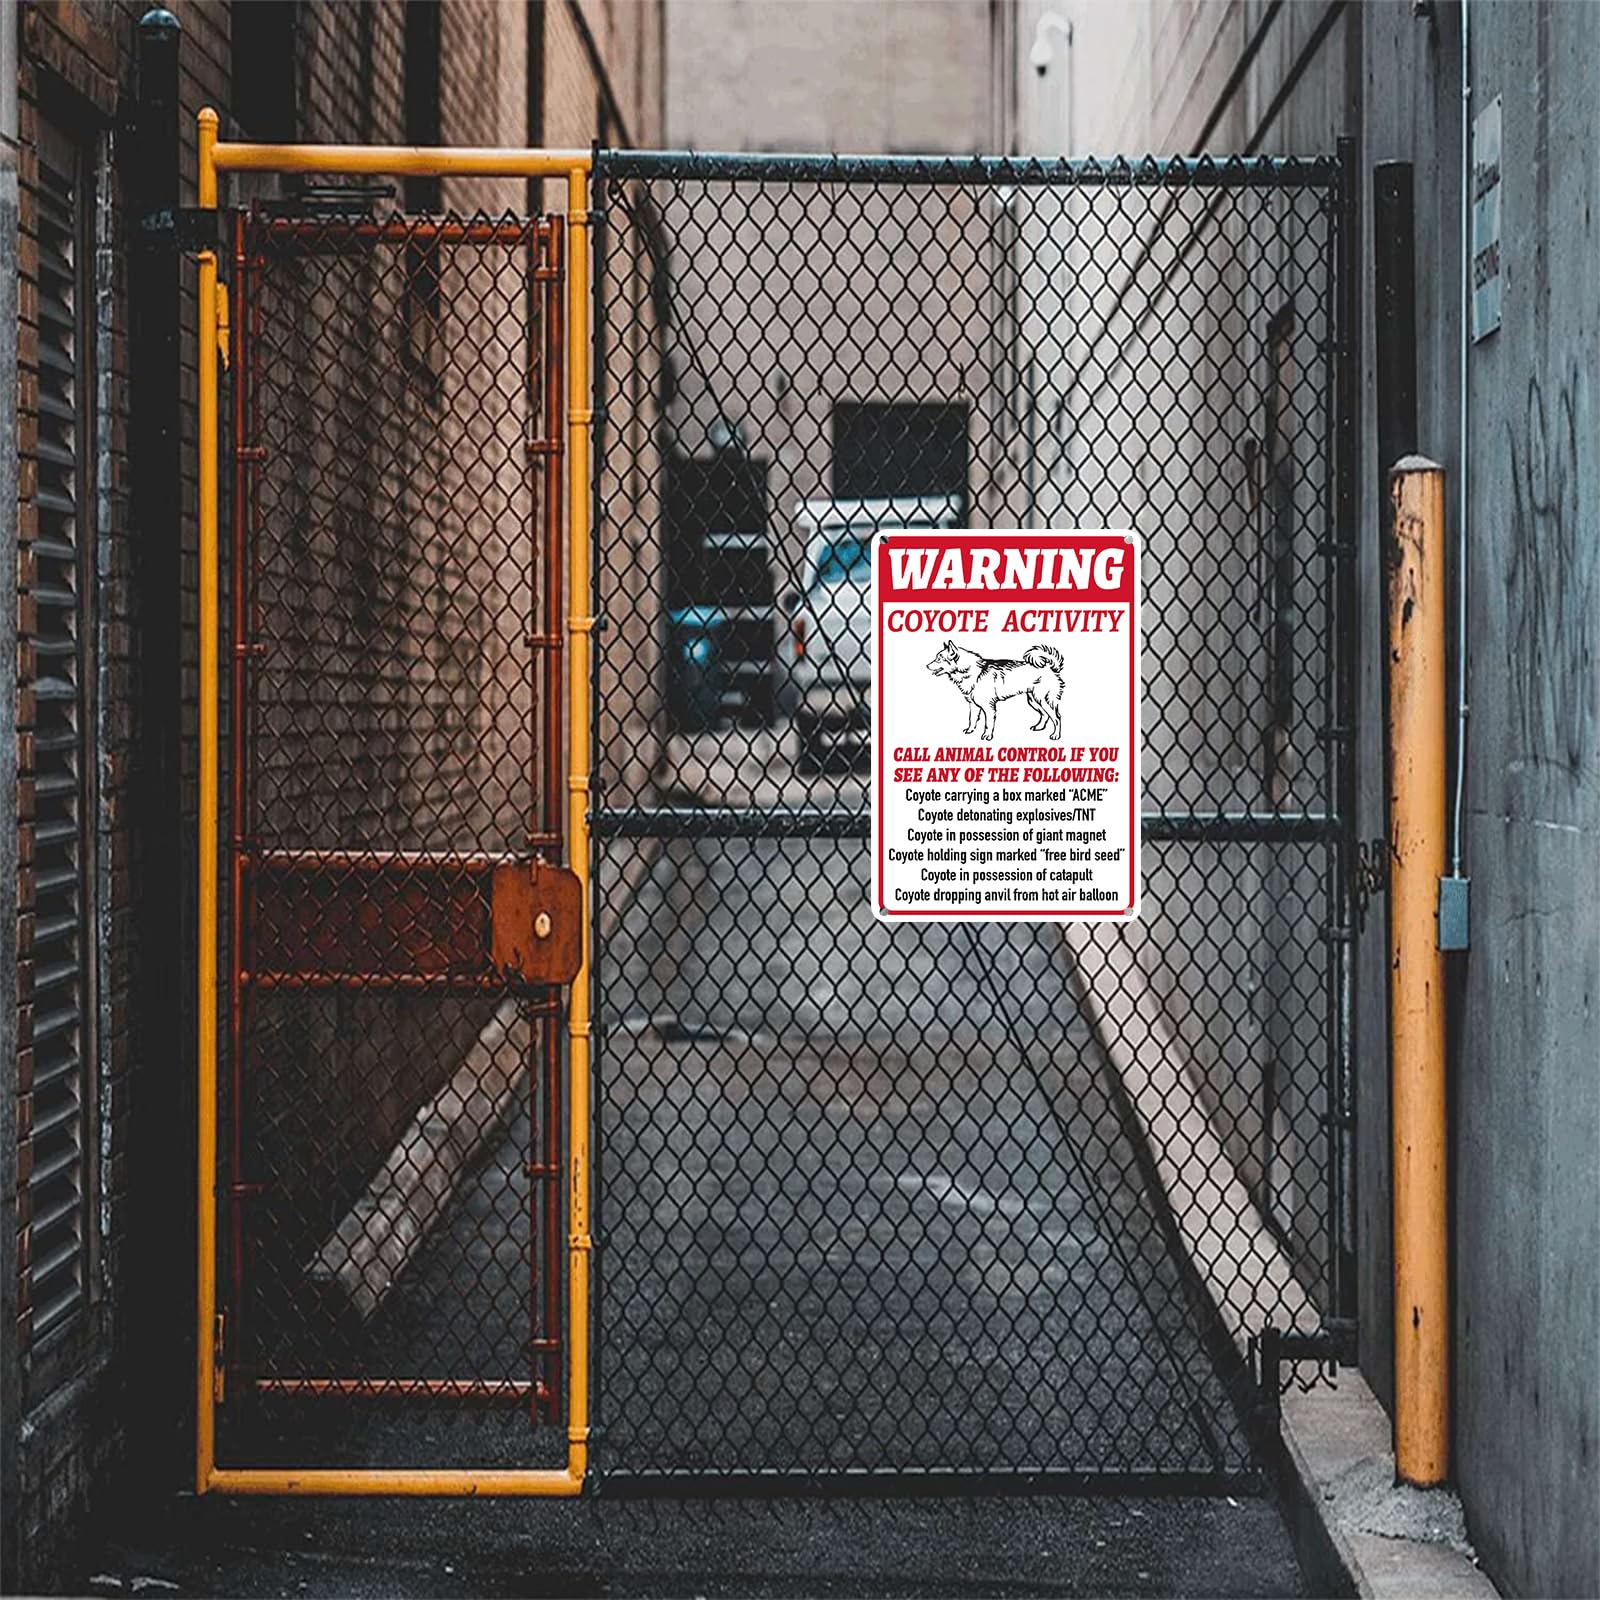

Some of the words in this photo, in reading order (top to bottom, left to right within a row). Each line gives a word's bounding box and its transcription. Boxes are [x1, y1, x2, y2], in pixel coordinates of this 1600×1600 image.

[889, 548, 1124, 589] WARNING
[888, 610, 989, 632] COYOTE
[1001, 610, 1125, 632] ACTIVITY
[894, 747, 931, 762] CALL
[934, 747, 994, 762] ANIMAL
[998, 747, 1066, 762] CONTROL
[1070, 747, 1085, 762] IF
[1089, 747, 1119, 762] YOU
[894, 768, 923, 782] SEE
[926, 768, 961, 782] ANY
[964, 768, 985, 782] OF
[988, 768, 1020, 782] THE
[1023, 768, 1119, 782] FOLLOWING:
[906, 788, 941, 803] Coyote
[945, 788, 989, 803] carrying
[993, 792, 999, 801] a
[1003, 788, 1022, 801] box
[1025, 788, 1065, 801] marked
[1069, 788, 1108, 801] “ACME”
[918, 808, 953, 823] Coyote
[957, 808, 1012, 823] detonating
[1016, 808, 1096, 823] explosives/TNT
[908, 828, 943, 843] Coyote
[946, 828, 956, 841] in
[960, 828, 1019, 843] possession
[1023, 828, 1033, 841] of
[1036, 828, 1063, 843] giant
[1066, 829, 1106, 843] magnet
[889, 848, 924, 863] Coyote
[928, 848, 966, 863] holding
[970, 848, 992, 863] sign
[996, 848, 1037, 861] marked
[1040, 848, 1066, 861] “free
[1070, 848, 1091, 861] bird
[1095, 848, 1125, 861] seed”
[921, 868, 956, 883] Coyote
[960, 868, 969, 881] in
[973, 868, 1032, 883] possession
[1036, 868, 1047, 881] of
[1050, 868, 1093, 883] catapult
[895, 888, 930, 904] Coyote
[934, 888, 981, 904] dropping
[985, 888, 1011, 901] anvil
[1013, 888, 1038, 901] from
[1042, 888, 1059, 901] hot
[1062, 888, 1077, 901] air
[1080, 888, 1118, 901] balloon
